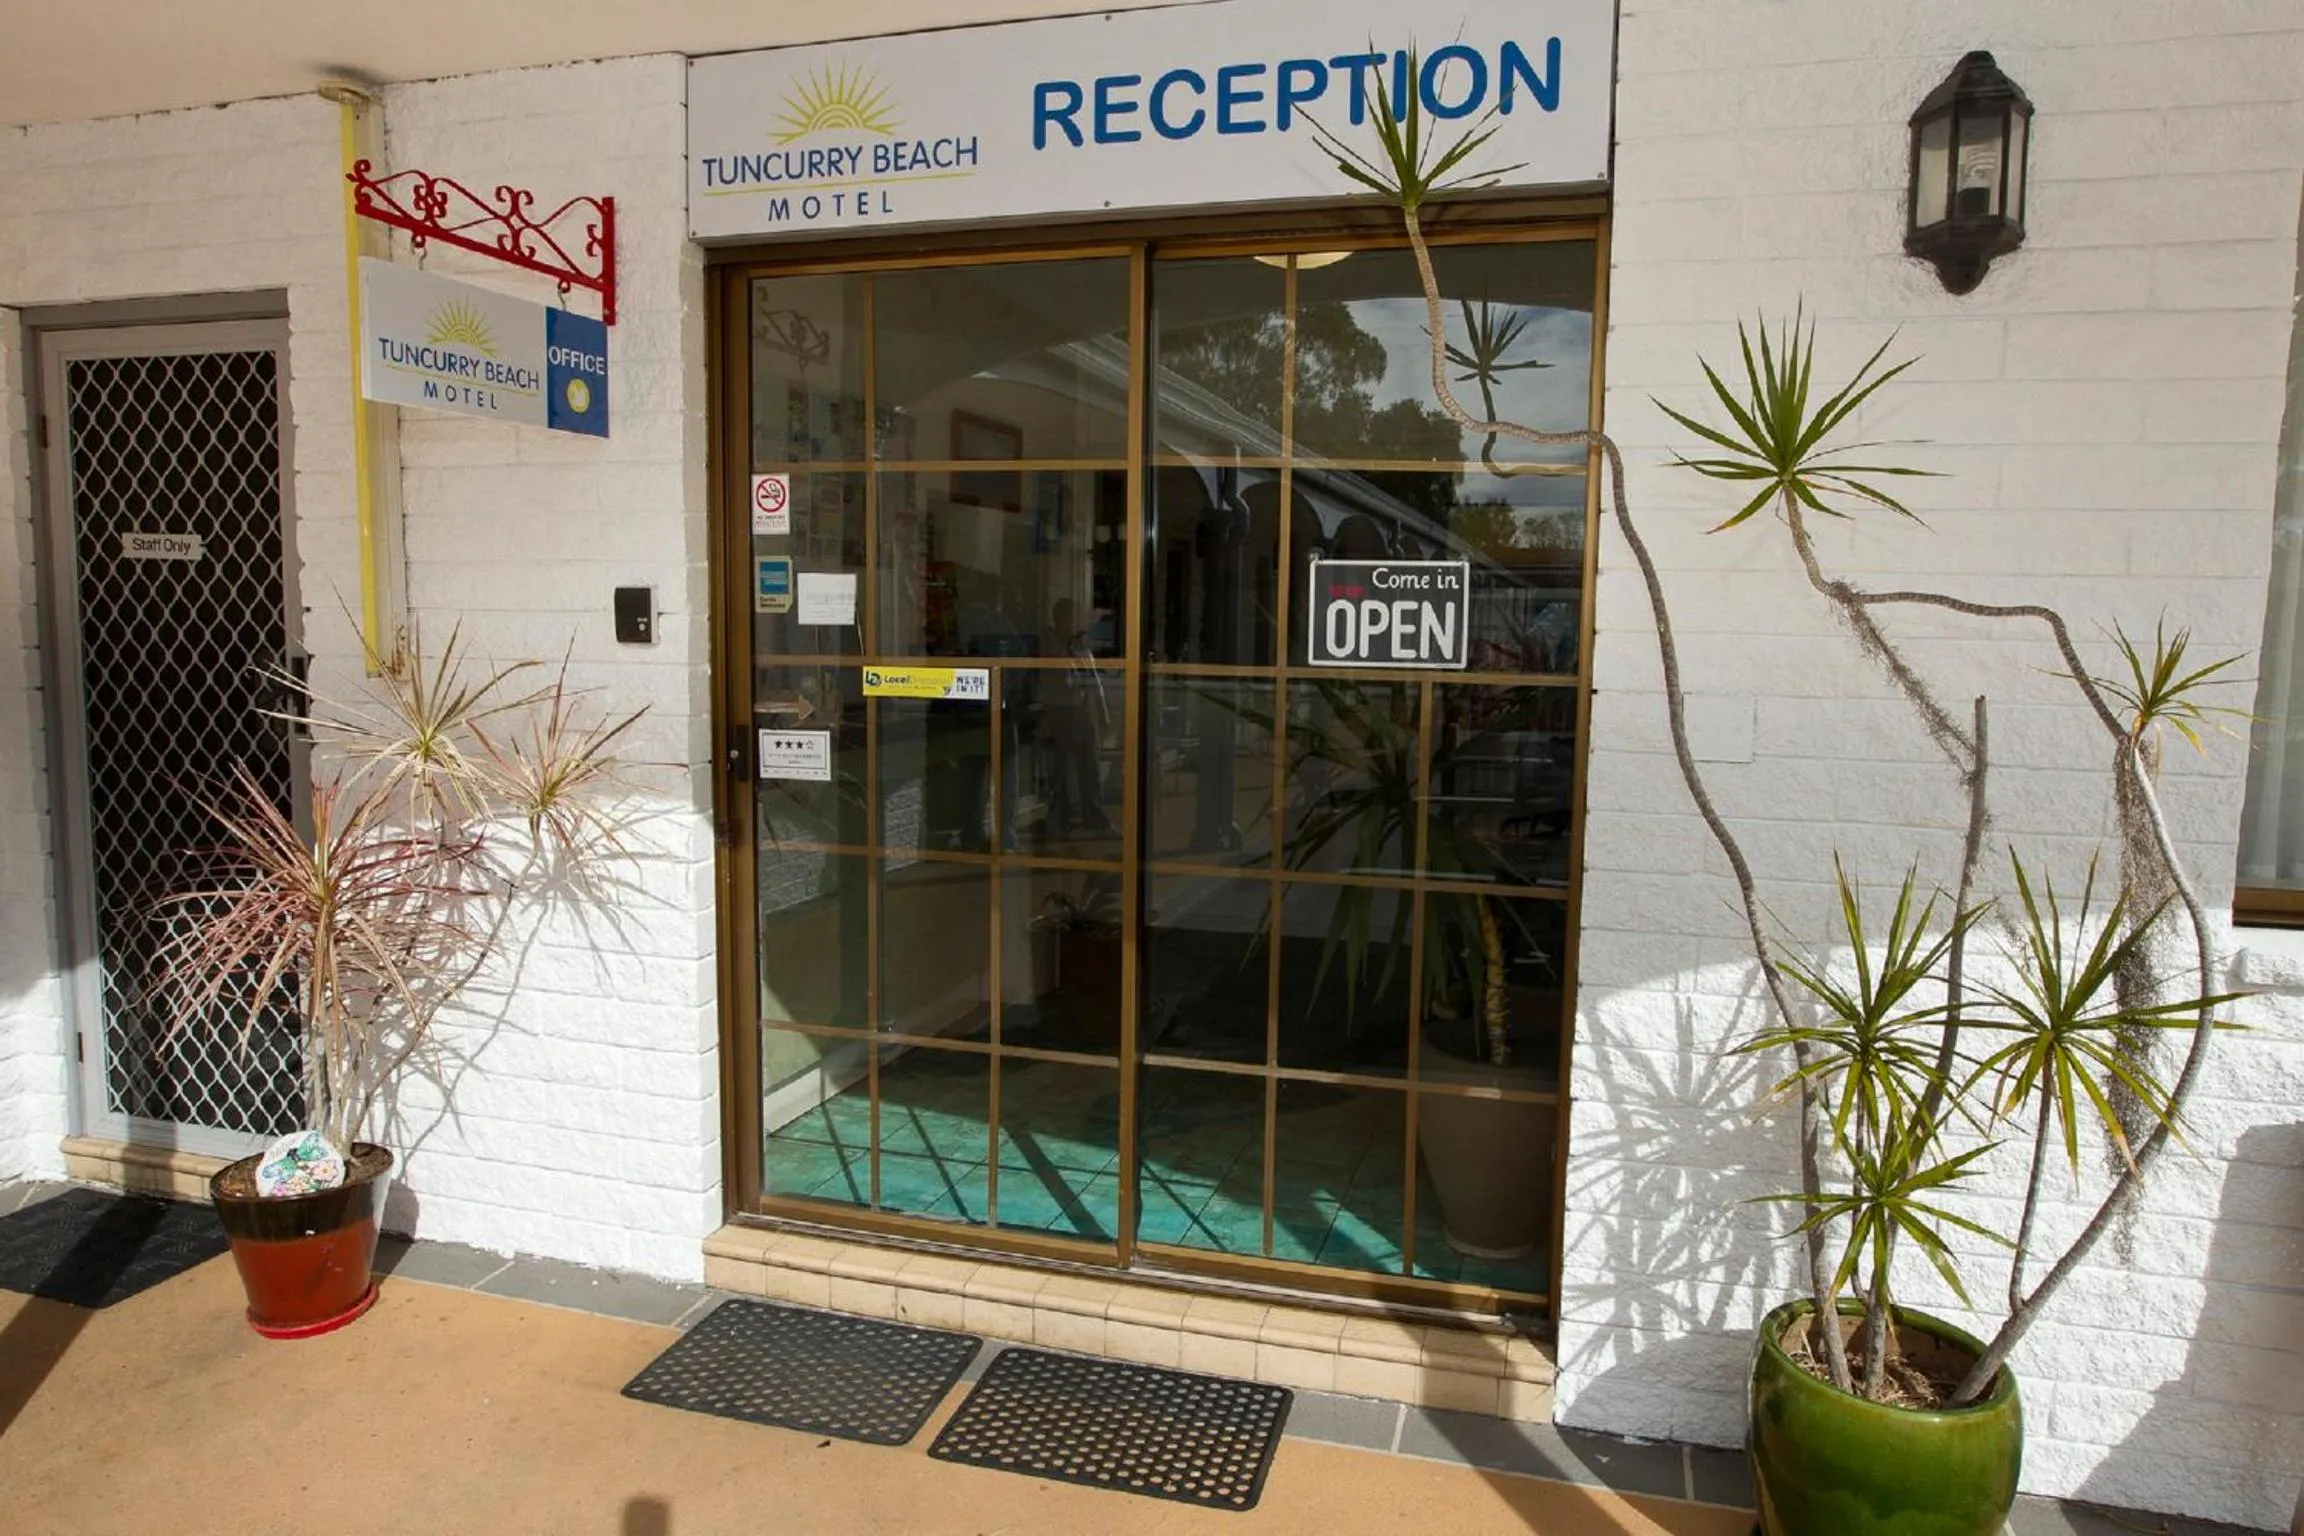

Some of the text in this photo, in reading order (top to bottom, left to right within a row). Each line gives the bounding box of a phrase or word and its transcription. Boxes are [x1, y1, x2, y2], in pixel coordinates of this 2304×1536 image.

[1033, 36, 1561, 150] RECEPTION
[702, 137, 978, 186] TUNCURRY BEACH
[768, 191, 893, 222] MOTEL
[378, 338, 539, 390] TUNCURRY BEACH
[548, 346, 605, 376] OFFICE
[424, 380, 497, 410] MOTEL
[133, 537, 191, 555] Staff Only
[1372, 567, 1460, 589] Come in
[1326, 599, 1456, 660] OPEN
